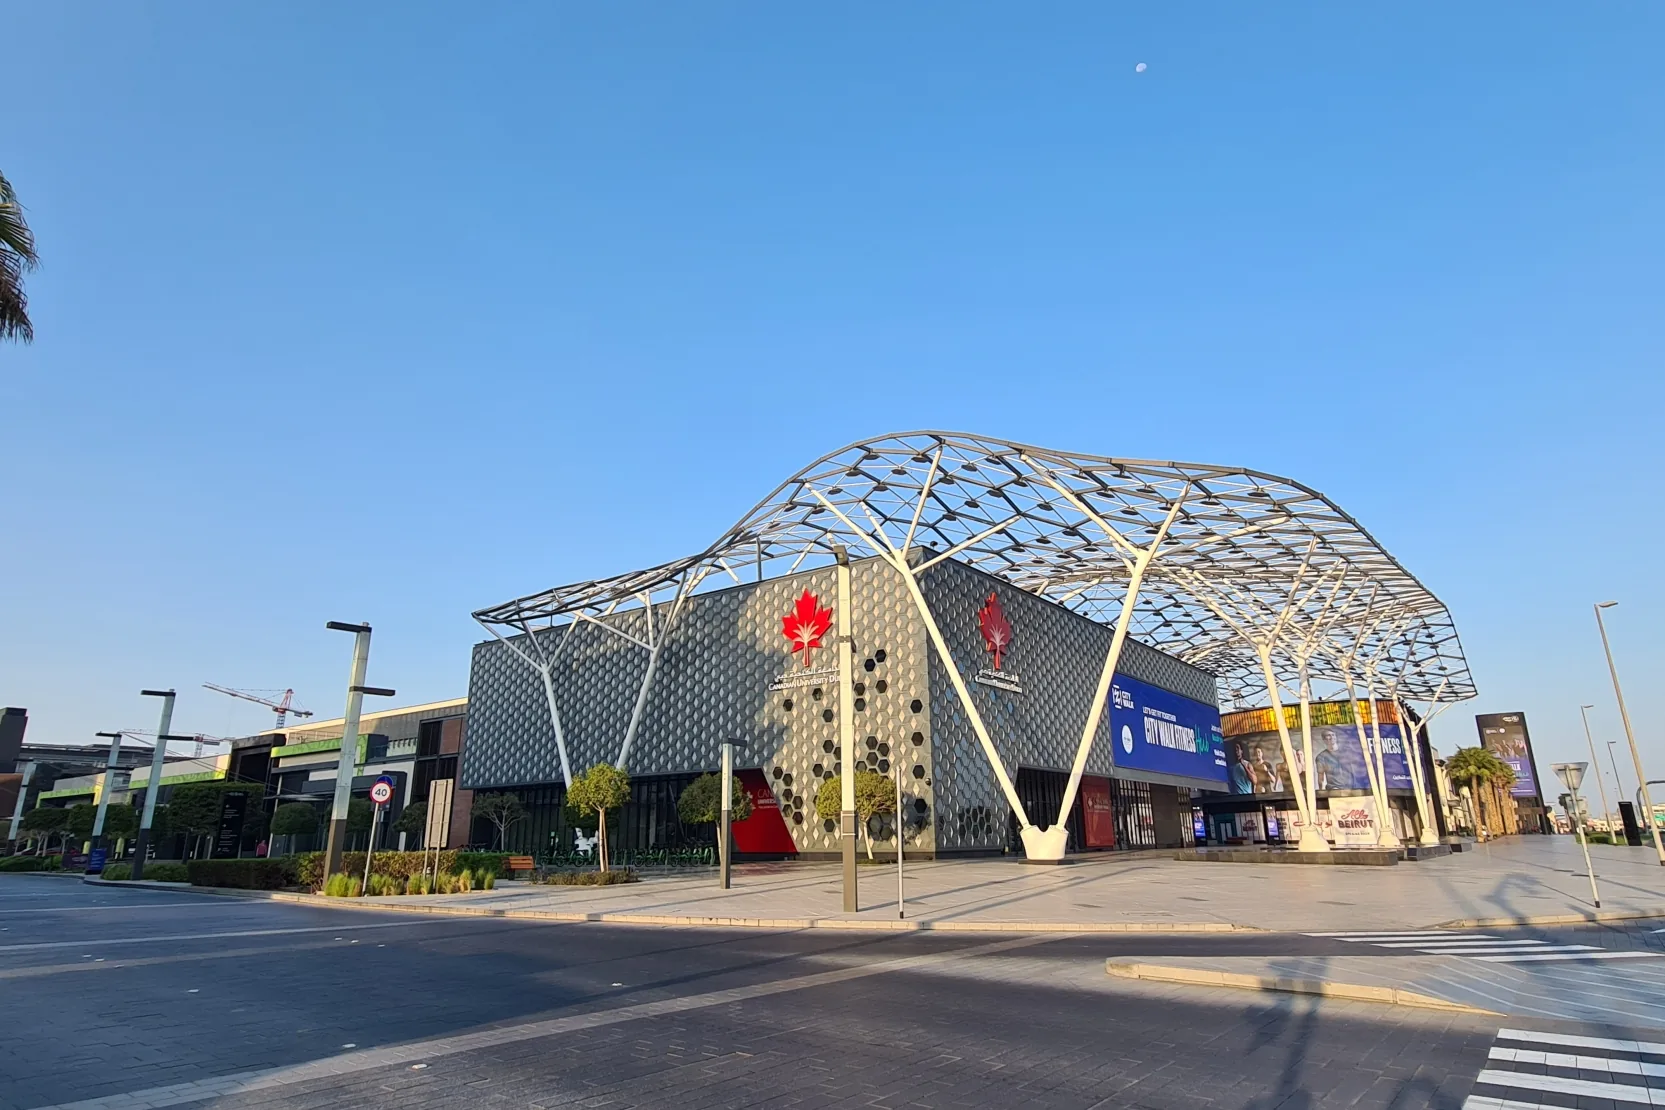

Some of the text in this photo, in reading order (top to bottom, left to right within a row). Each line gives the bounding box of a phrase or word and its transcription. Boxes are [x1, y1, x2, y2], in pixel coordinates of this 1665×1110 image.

[796, 677, 828, 688] UNIVERSITY
[1144, 716, 1159, 745] CITY
[1158, 719, 1176, 749] WALK
[1174, 724, 1196, 753] FITNESS
[1367, 738, 1401, 754] FINESS
[375, 789, 387, 797] 40
[1338, 820, 1373, 828] BEIRUT
